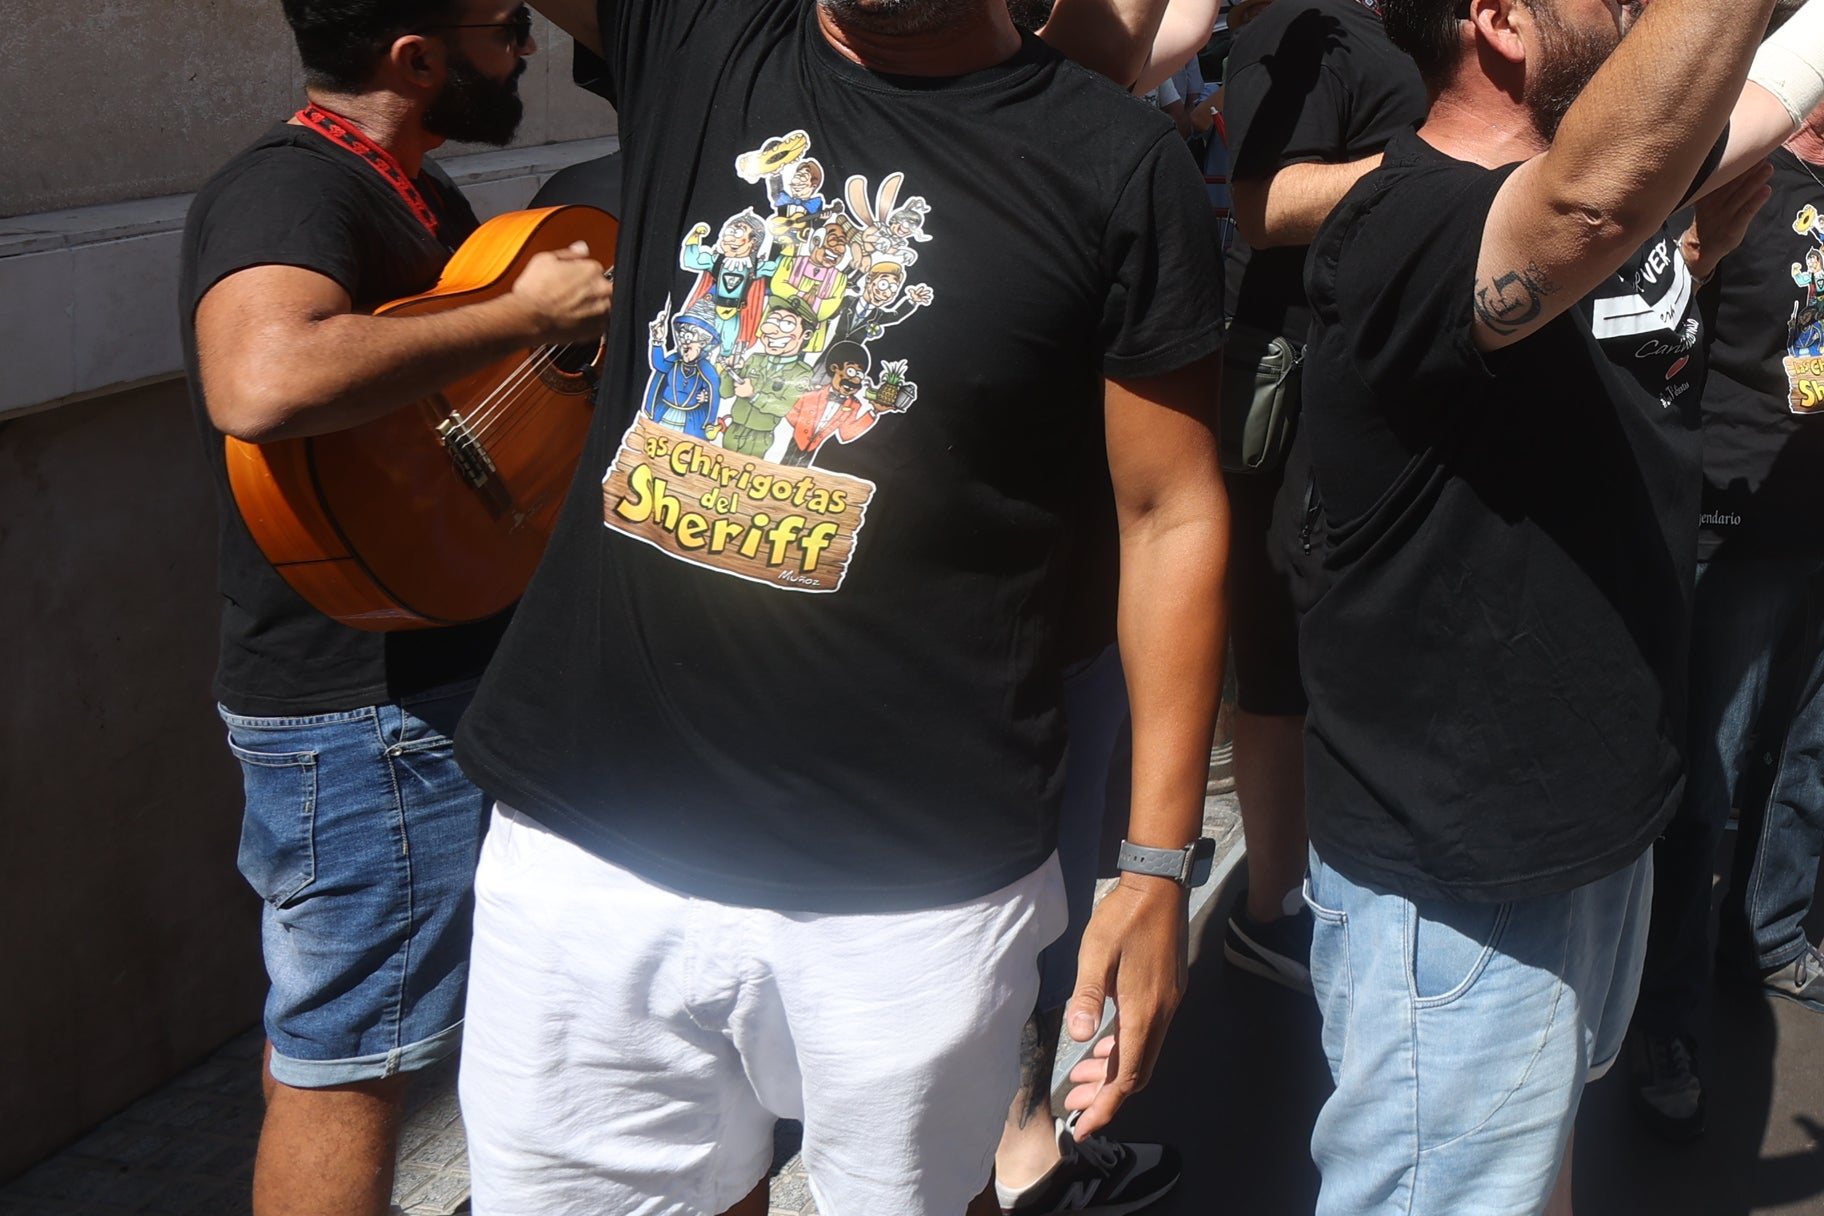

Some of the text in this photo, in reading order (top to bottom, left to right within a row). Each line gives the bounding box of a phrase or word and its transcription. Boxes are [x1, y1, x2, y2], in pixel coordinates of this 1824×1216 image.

[645, 436, 848, 515] as Chirigotas
[699, 487, 739, 514] del
[614, 463, 839, 573] Sheriff
[776, 569, 821, 587] Muñoz
